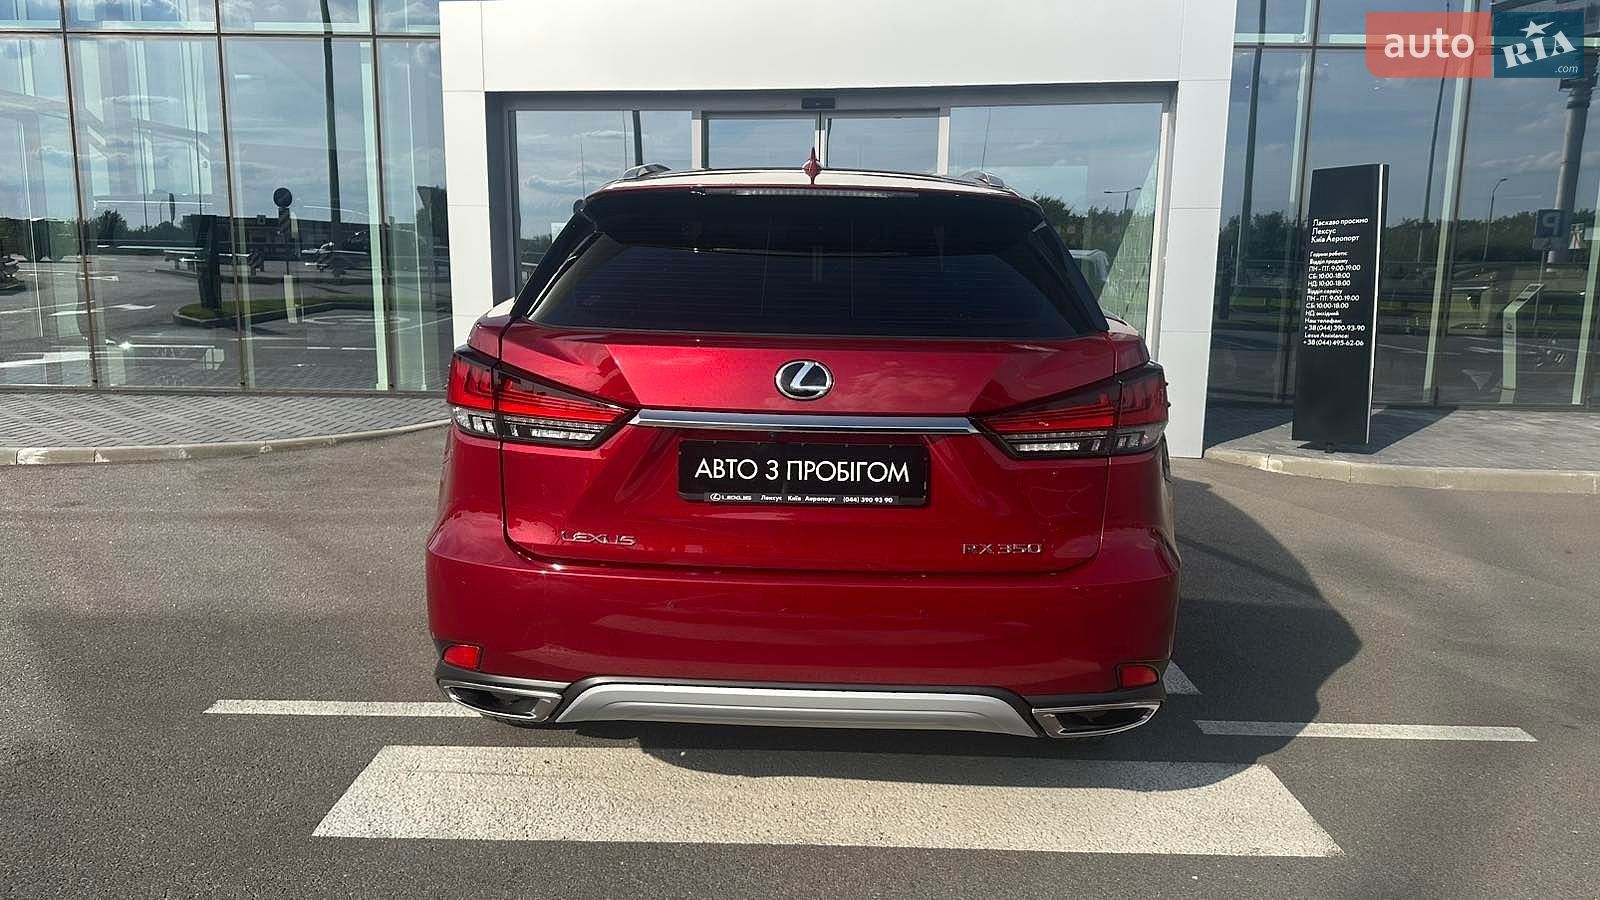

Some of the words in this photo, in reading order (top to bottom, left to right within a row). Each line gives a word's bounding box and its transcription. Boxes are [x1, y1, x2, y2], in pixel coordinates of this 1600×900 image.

[1312, 218, 1340, 227] Ласкаво
[1340, 218, 1369, 226] просимо
[1311, 227, 1337, 236] Лексус
[1326, 234, 1360, 243] Аеропорт
[694, 457, 758, 481] АВТО
[765, 459, 779, 481] З
[786, 460, 910, 483] ПРОБІГОМ
[760, 494, 783, 502] Лексус
[804, 495, 836, 503] Аеропорт
[842, 496, 860, 504] (044)
[561, 530, 636, 546] LEXUS
[962, 543, 995, 555] RX
[997, 543, 1042, 554] 350
